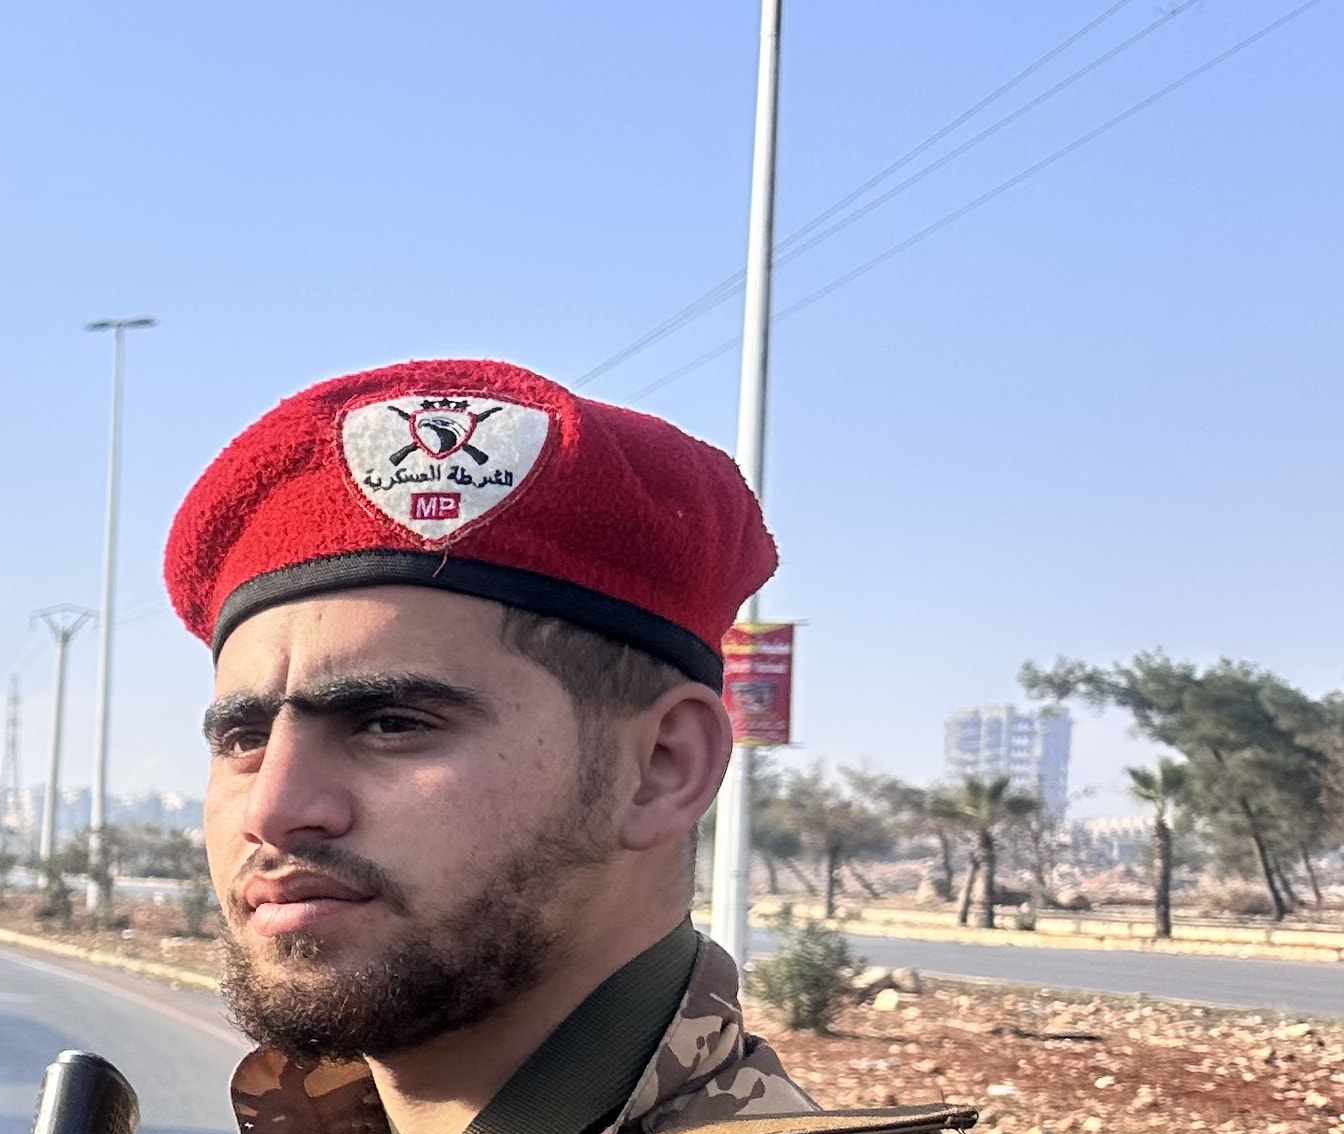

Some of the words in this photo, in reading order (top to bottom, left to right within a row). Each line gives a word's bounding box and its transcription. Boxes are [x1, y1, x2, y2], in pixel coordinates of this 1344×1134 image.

[363, 464, 442, 492] العسكرية
[447, 465, 513, 488] الشرطة
[416, 496, 455, 518] MP
